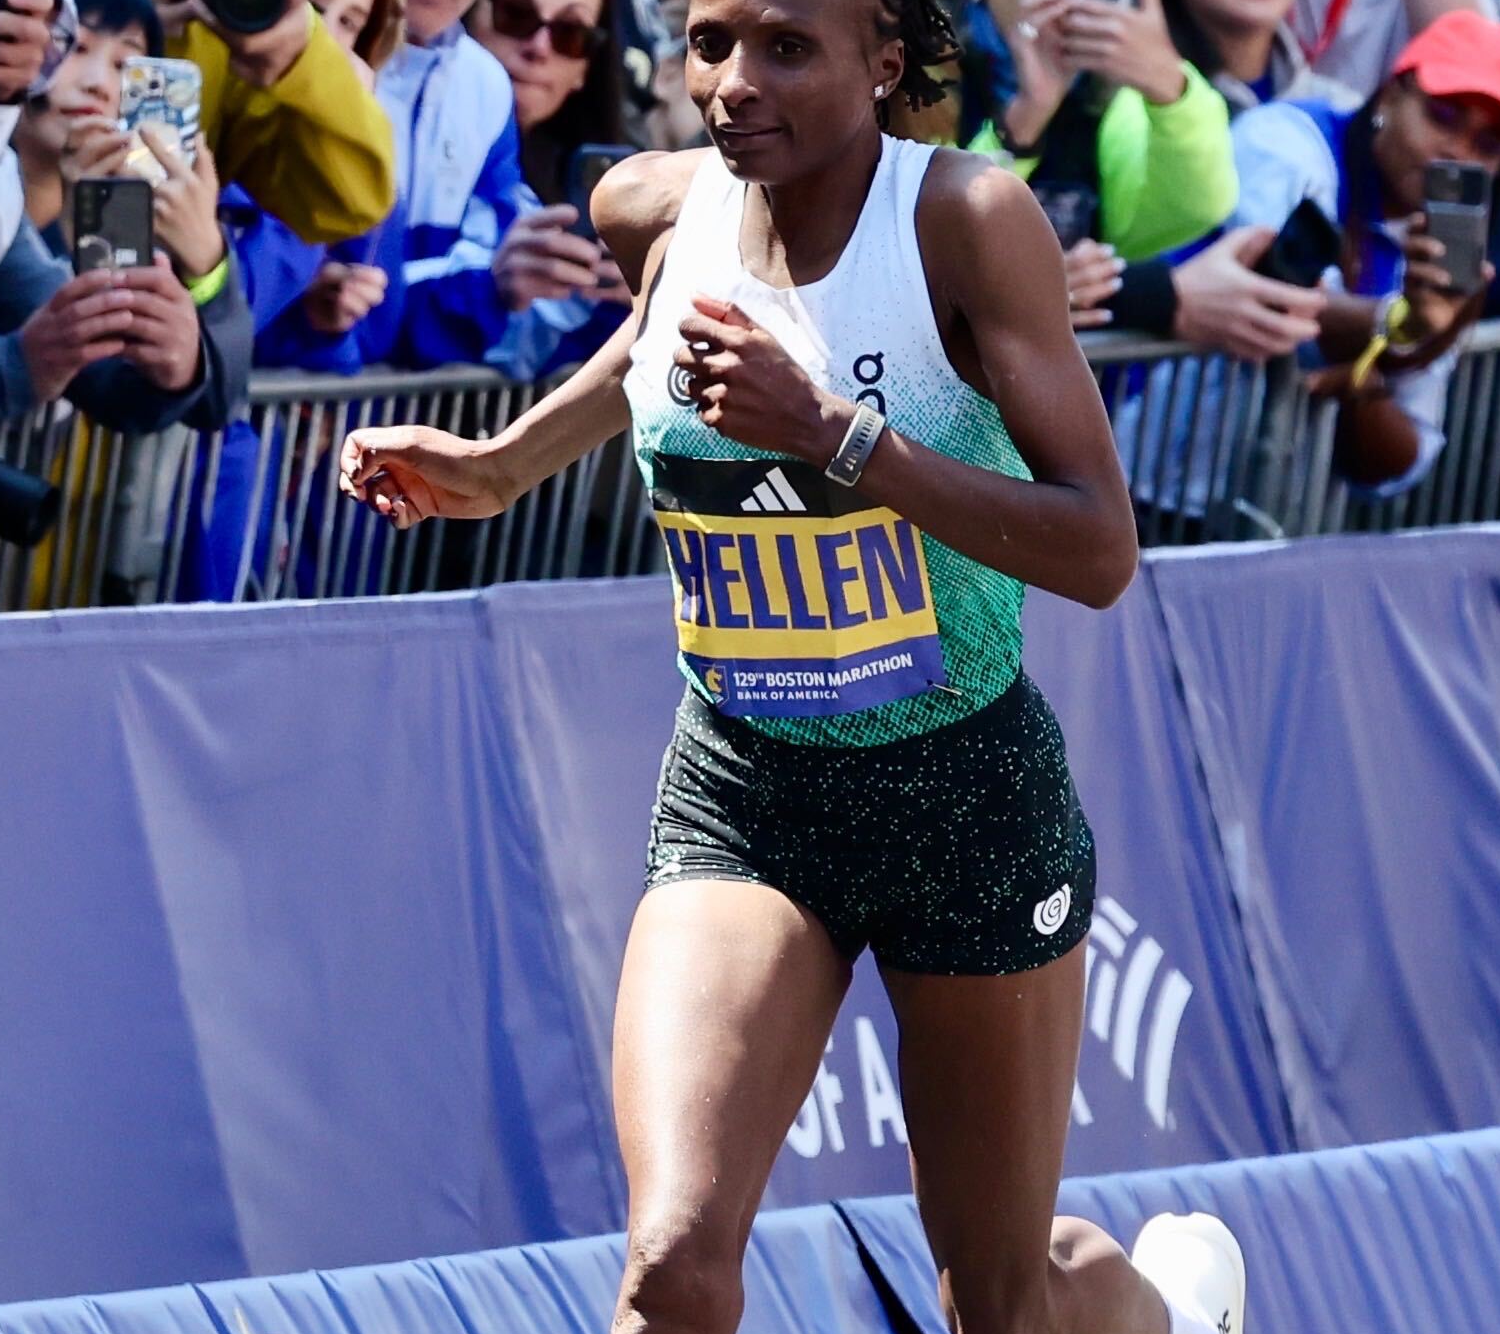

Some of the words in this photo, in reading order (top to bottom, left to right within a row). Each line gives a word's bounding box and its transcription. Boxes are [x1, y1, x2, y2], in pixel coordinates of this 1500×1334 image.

[663, 520, 928, 631] HELLEN
[766, 671, 826, 688] BOSTON
[827, 652, 914, 687] MARATHON
[737, 690, 768, 701] BANK
[771, 690, 785, 700] OF
[787, 690, 840, 700] AMERICA
